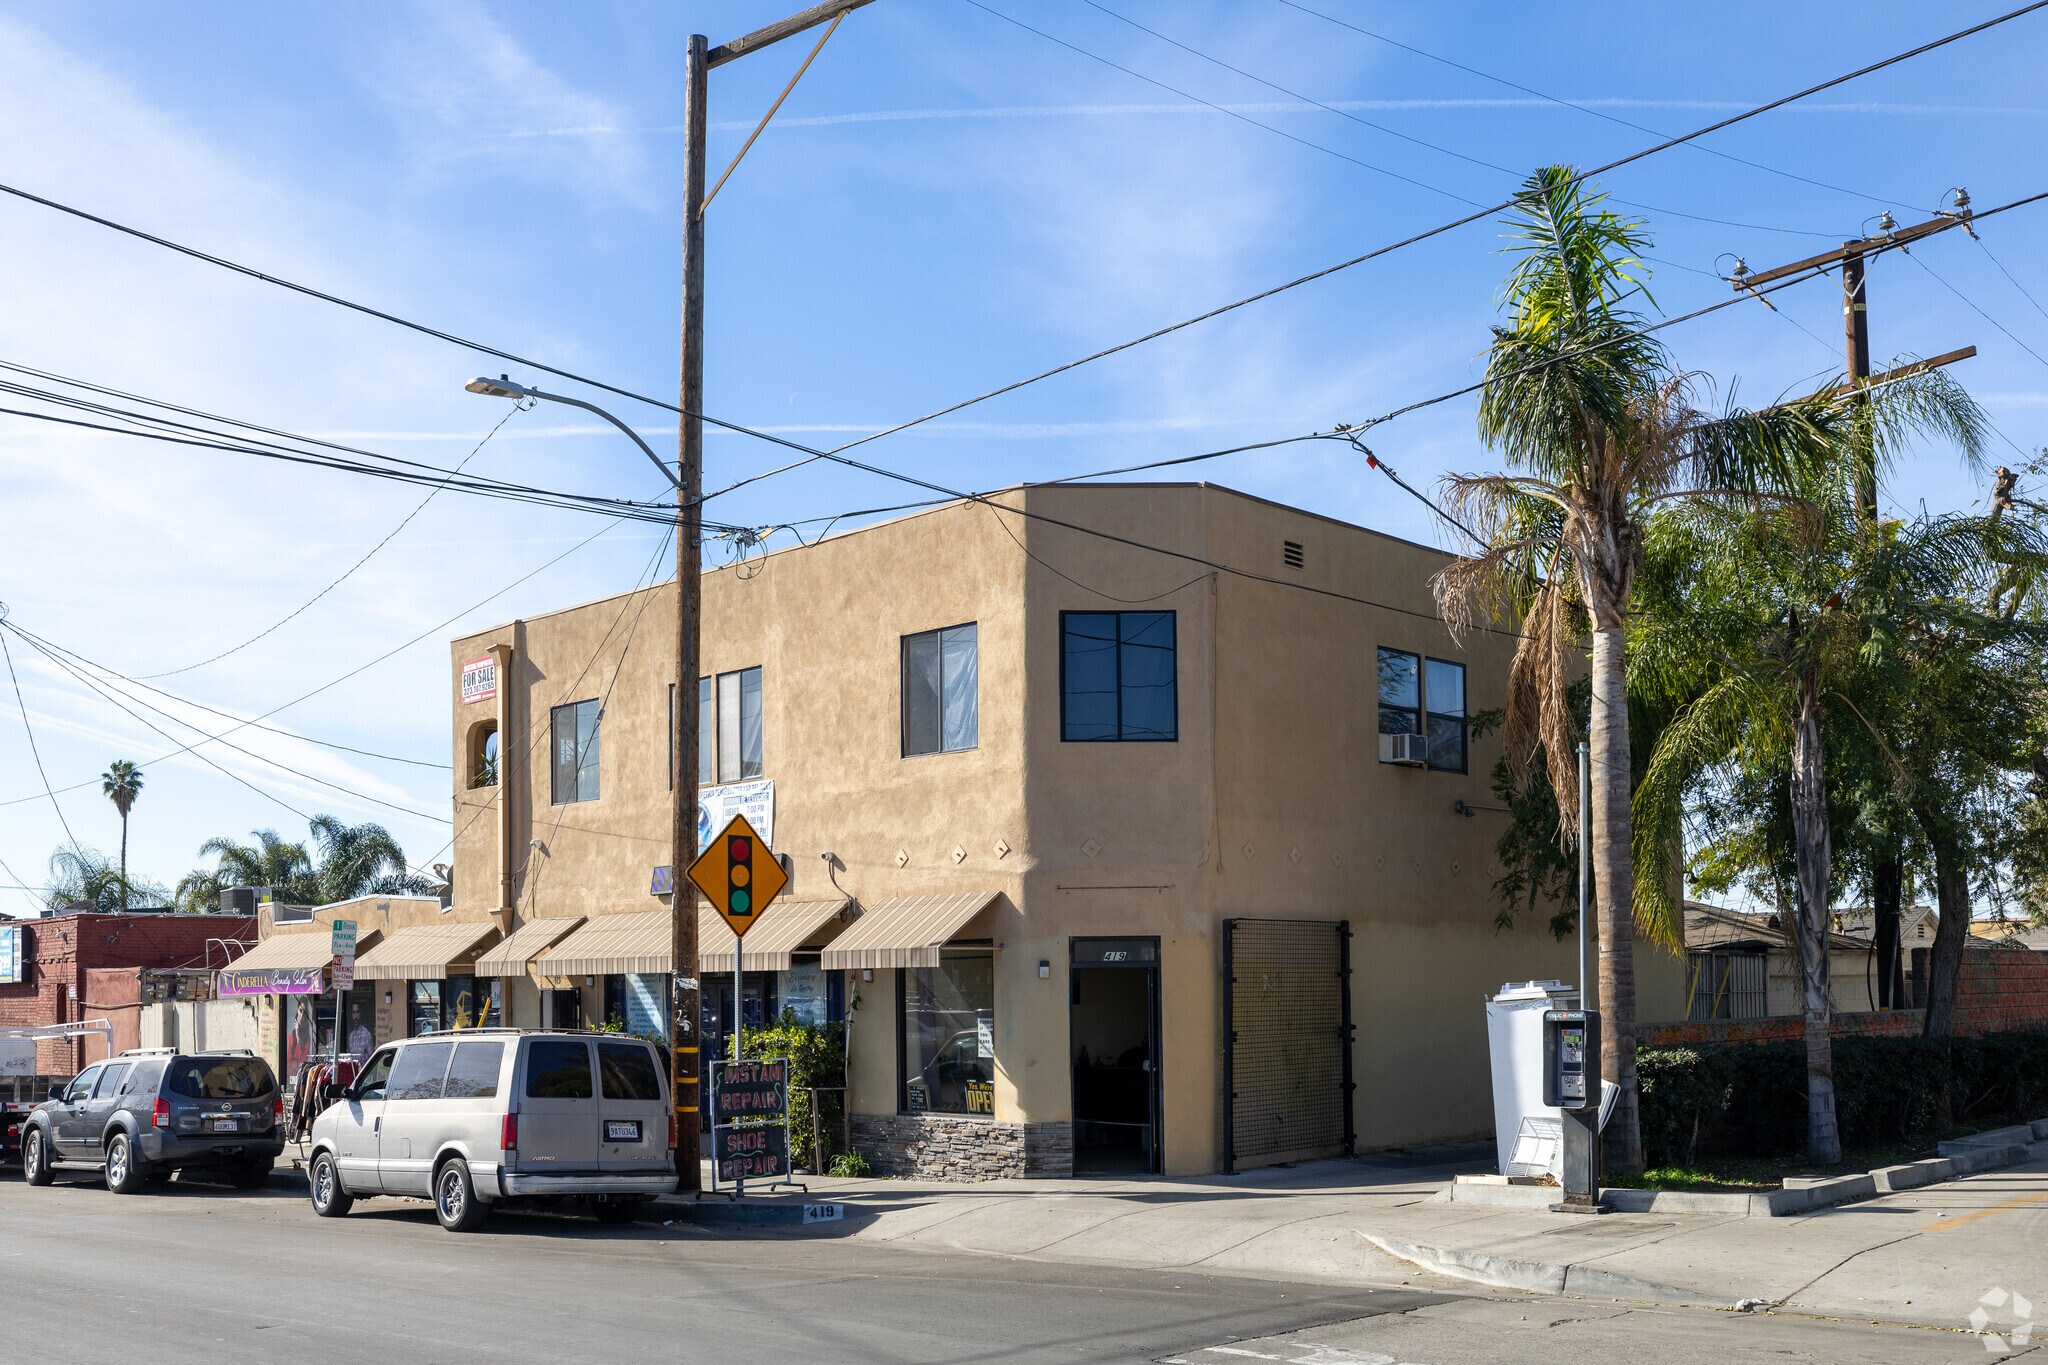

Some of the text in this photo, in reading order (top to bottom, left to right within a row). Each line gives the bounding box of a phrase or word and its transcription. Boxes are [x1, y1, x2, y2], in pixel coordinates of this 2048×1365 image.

[463, 667, 494, 688] FOR SALE
[757, 804, 764, 812] PM
[334, 932, 355, 941] PARKING
[333, 956, 341, 965] NO
[1104, 952, 1125, 961] 419
[333, 966, 353, 974] PARKING
[231, 972, 269, 993] CINDERELLA
[271, 969, 291, 992] Beauty
[292, 969, 308, 985] Salon
[721, 1090, 777, 1111] REPAIR
[610, 1127, 637, 1136] 9ATU346
[727, 1131, 767, 1152] SHOE
[722, 1155, 778, 1179] REPAIR
[810, 1205, 834, 1219] 419
